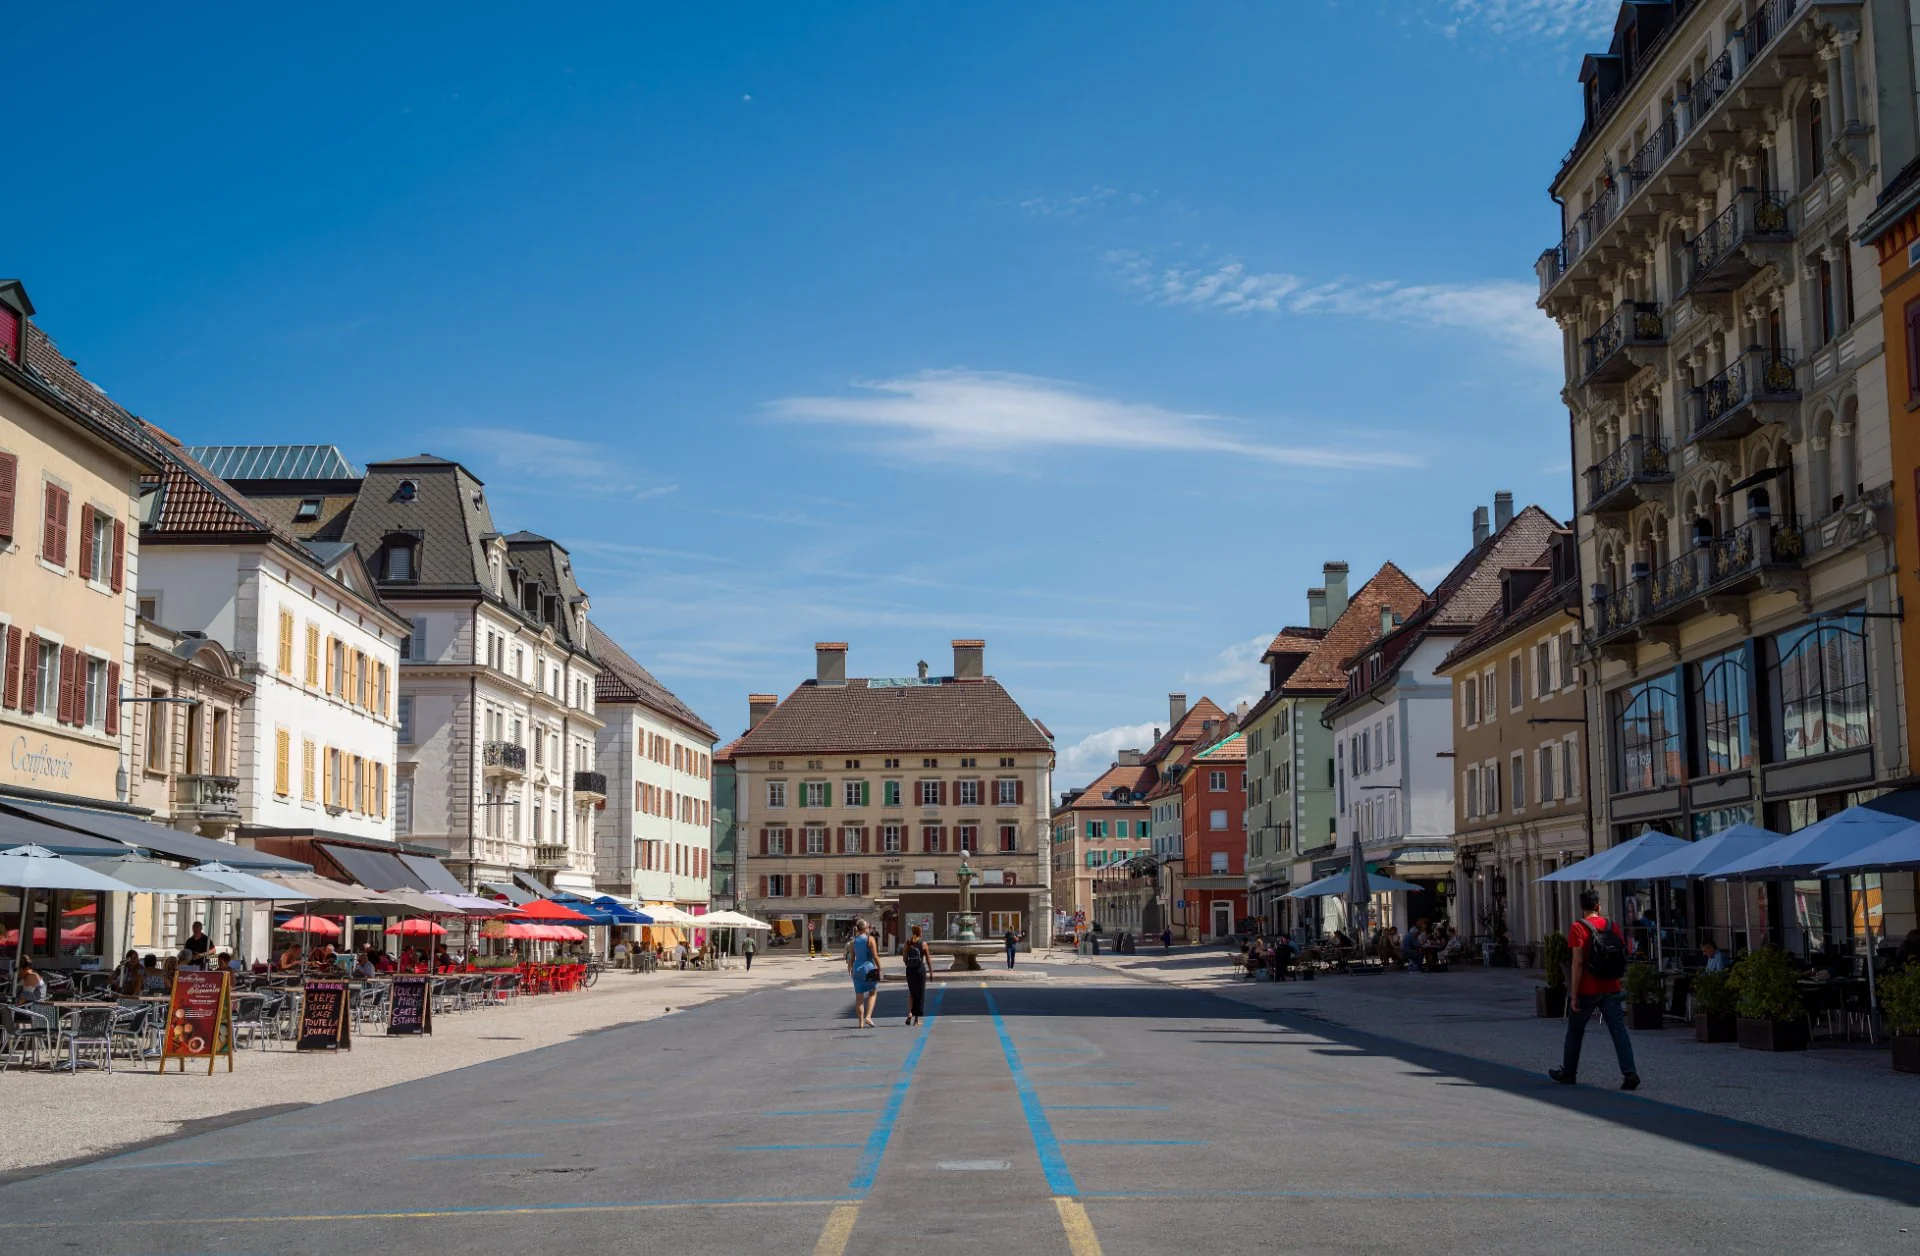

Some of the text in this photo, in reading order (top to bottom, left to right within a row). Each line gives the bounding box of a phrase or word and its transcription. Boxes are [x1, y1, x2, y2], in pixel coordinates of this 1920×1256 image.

[11, 735, 73, 781] Confiserie
[392, 1007, 417, 1017] CARTE
[304, 1018, 338, 1027] TOUTE LA
